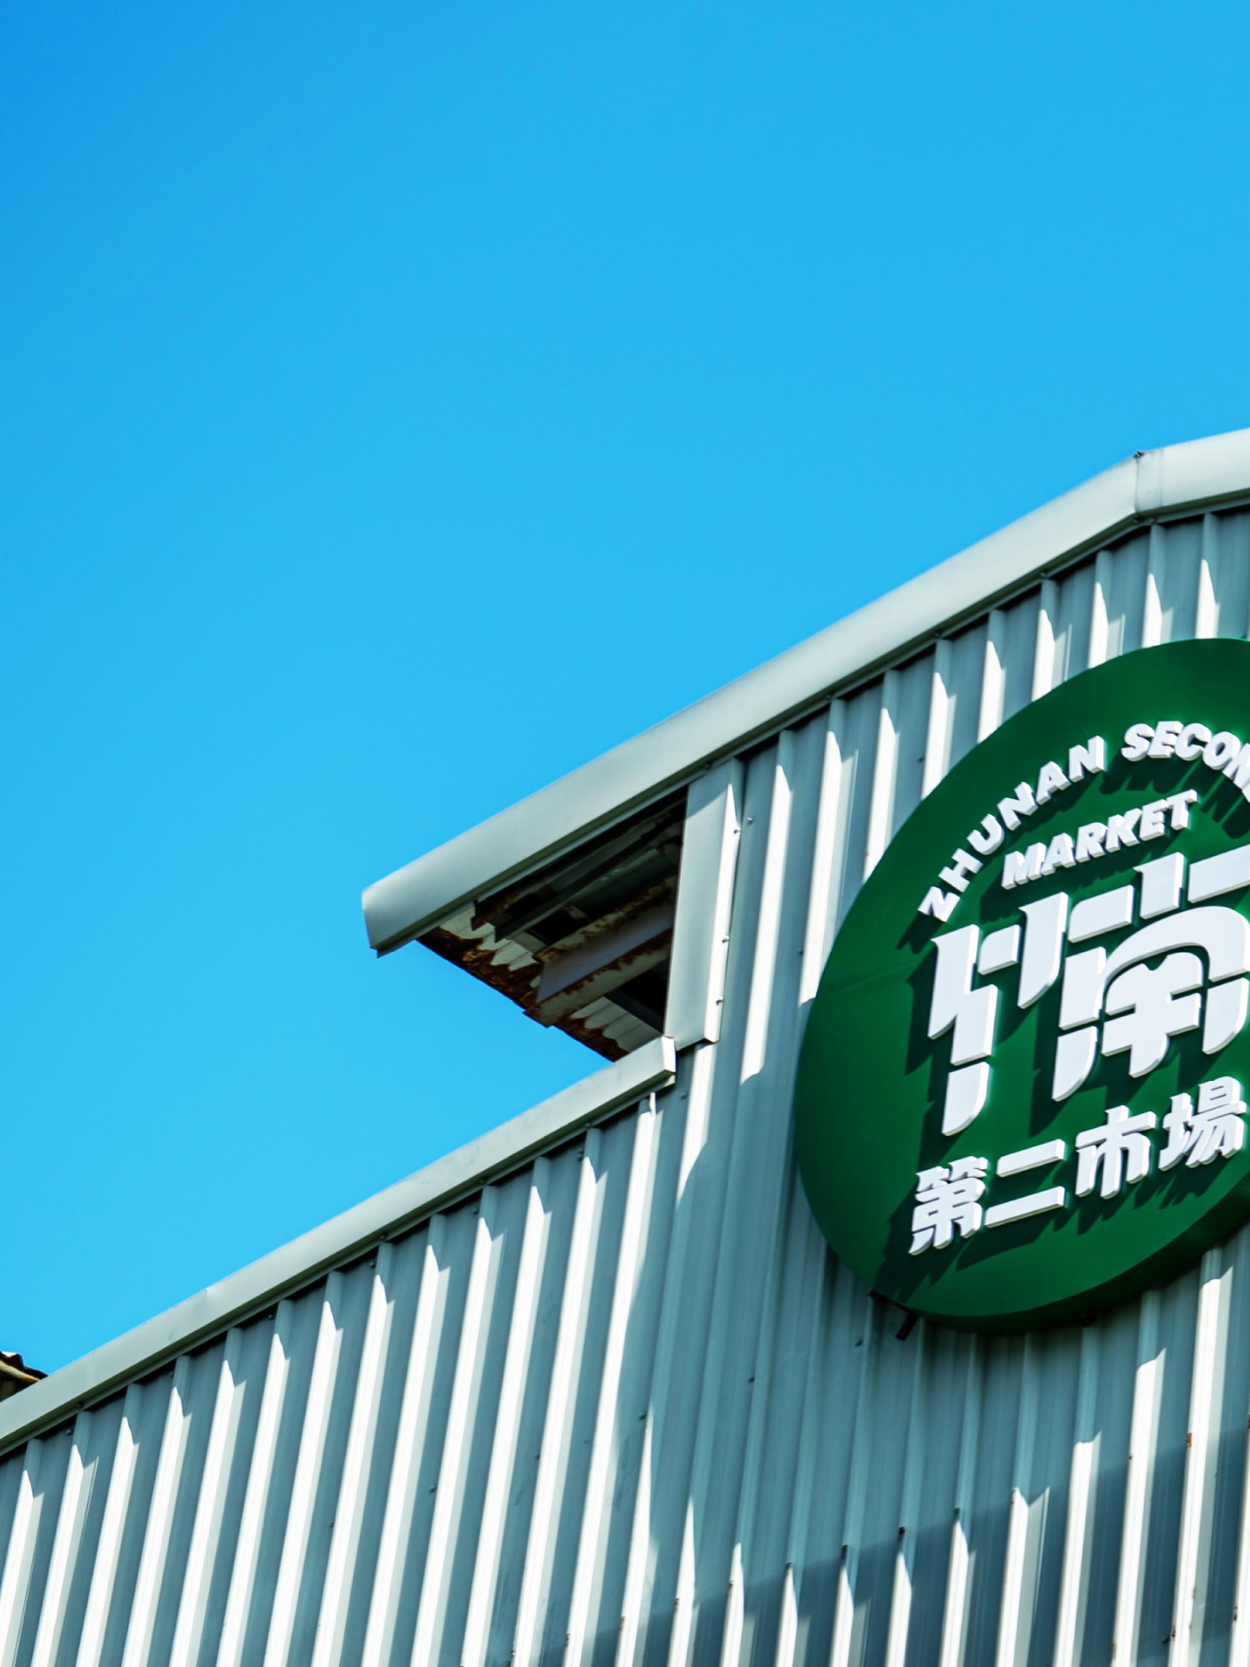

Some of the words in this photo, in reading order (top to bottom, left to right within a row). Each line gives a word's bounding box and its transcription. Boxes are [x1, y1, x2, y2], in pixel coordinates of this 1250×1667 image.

[917, 734, 1106, 923] ZHUNAN
[1000, 789, 1199, 891] MARKET
[908, 1076, 1249, 1256] 第二市場
